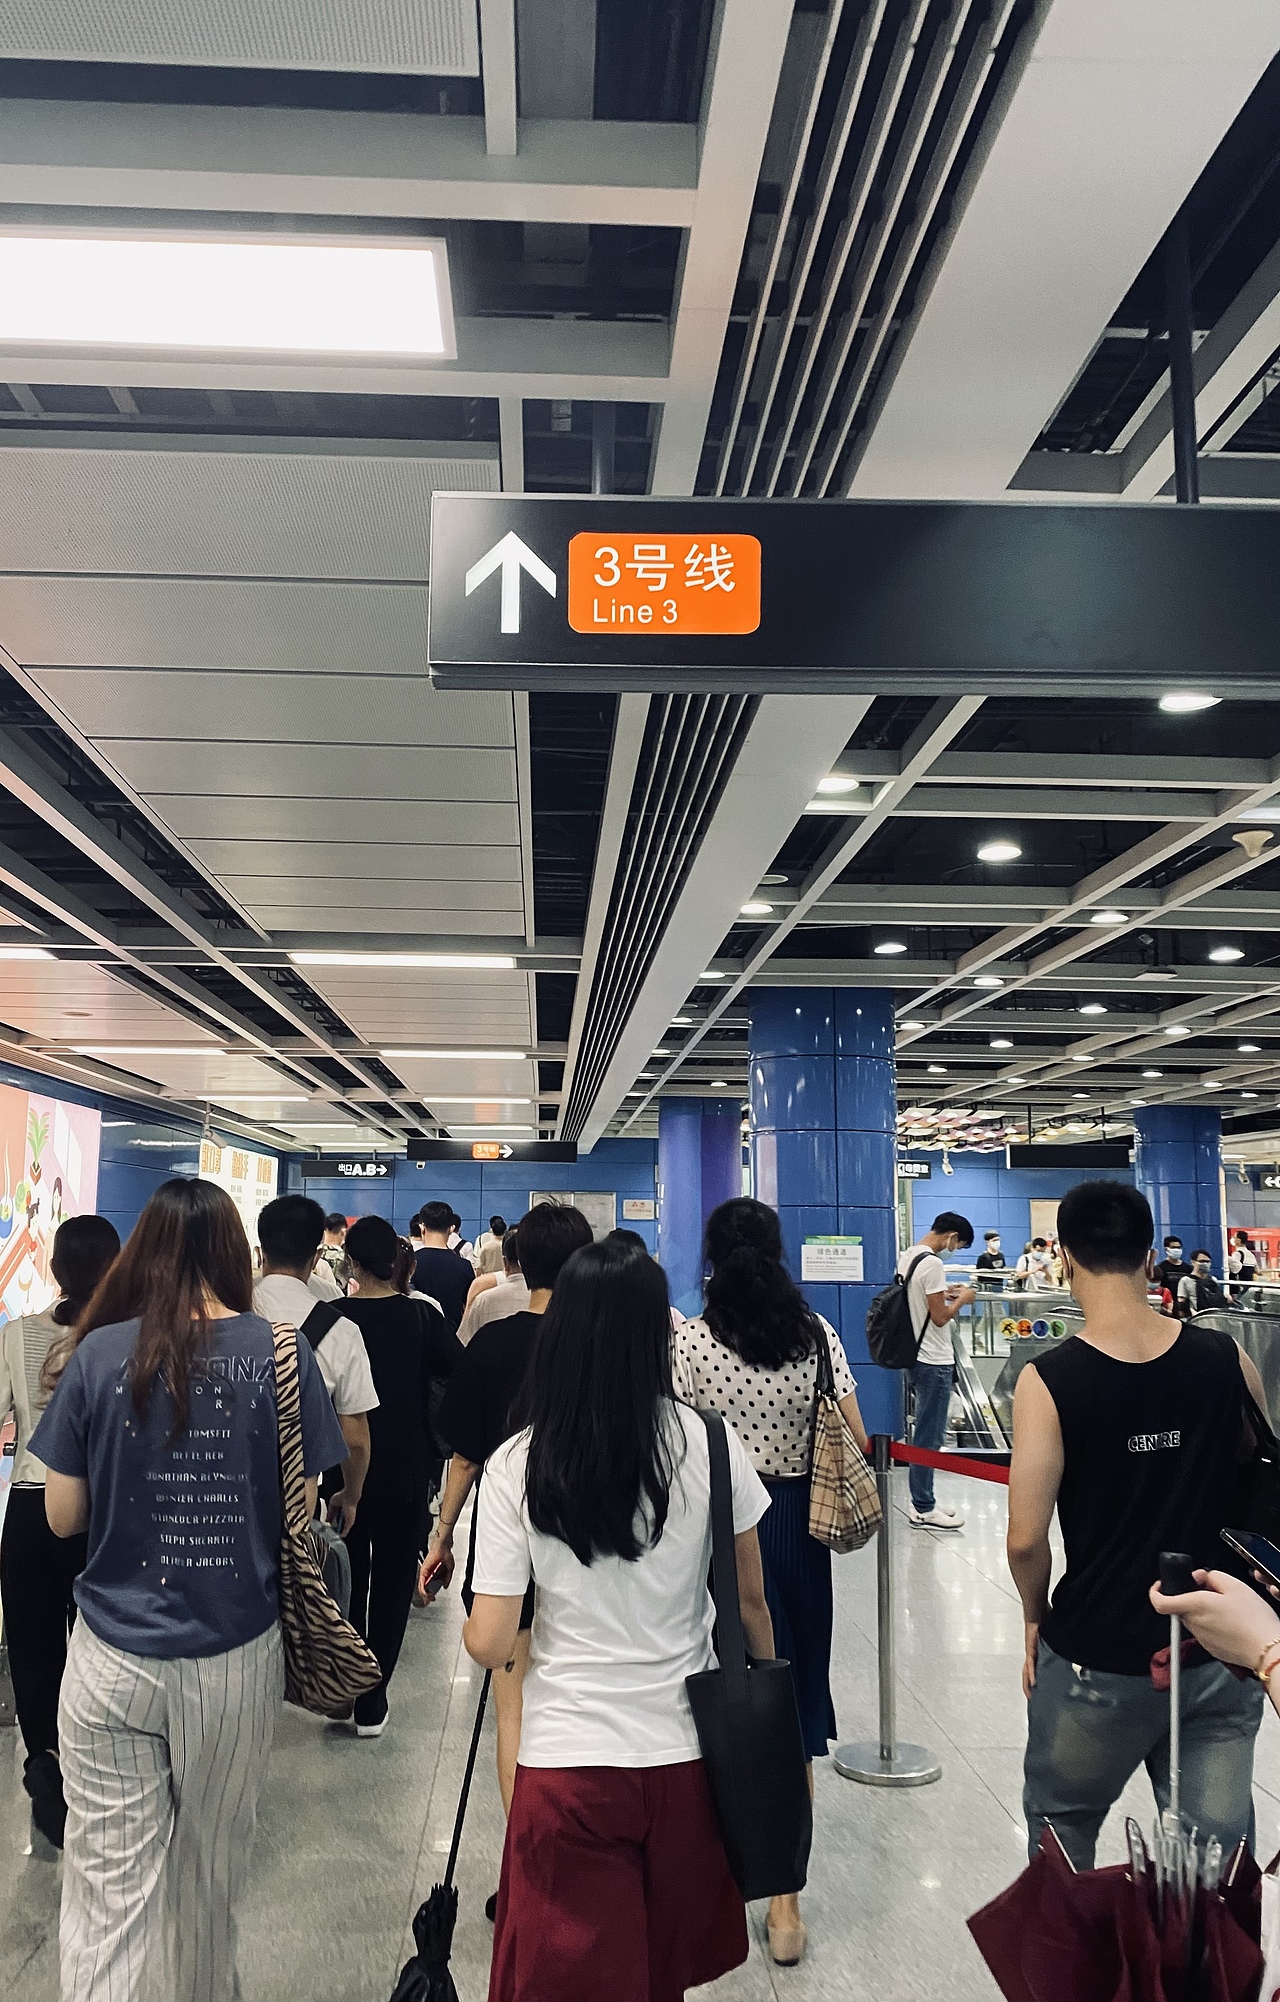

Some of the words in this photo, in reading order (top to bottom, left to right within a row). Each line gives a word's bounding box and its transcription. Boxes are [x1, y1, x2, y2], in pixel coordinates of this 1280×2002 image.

[594, 543, 736, 592] 3号线
[593, 598, 653, 624] Line
[662, 599, 678, 624] 3
